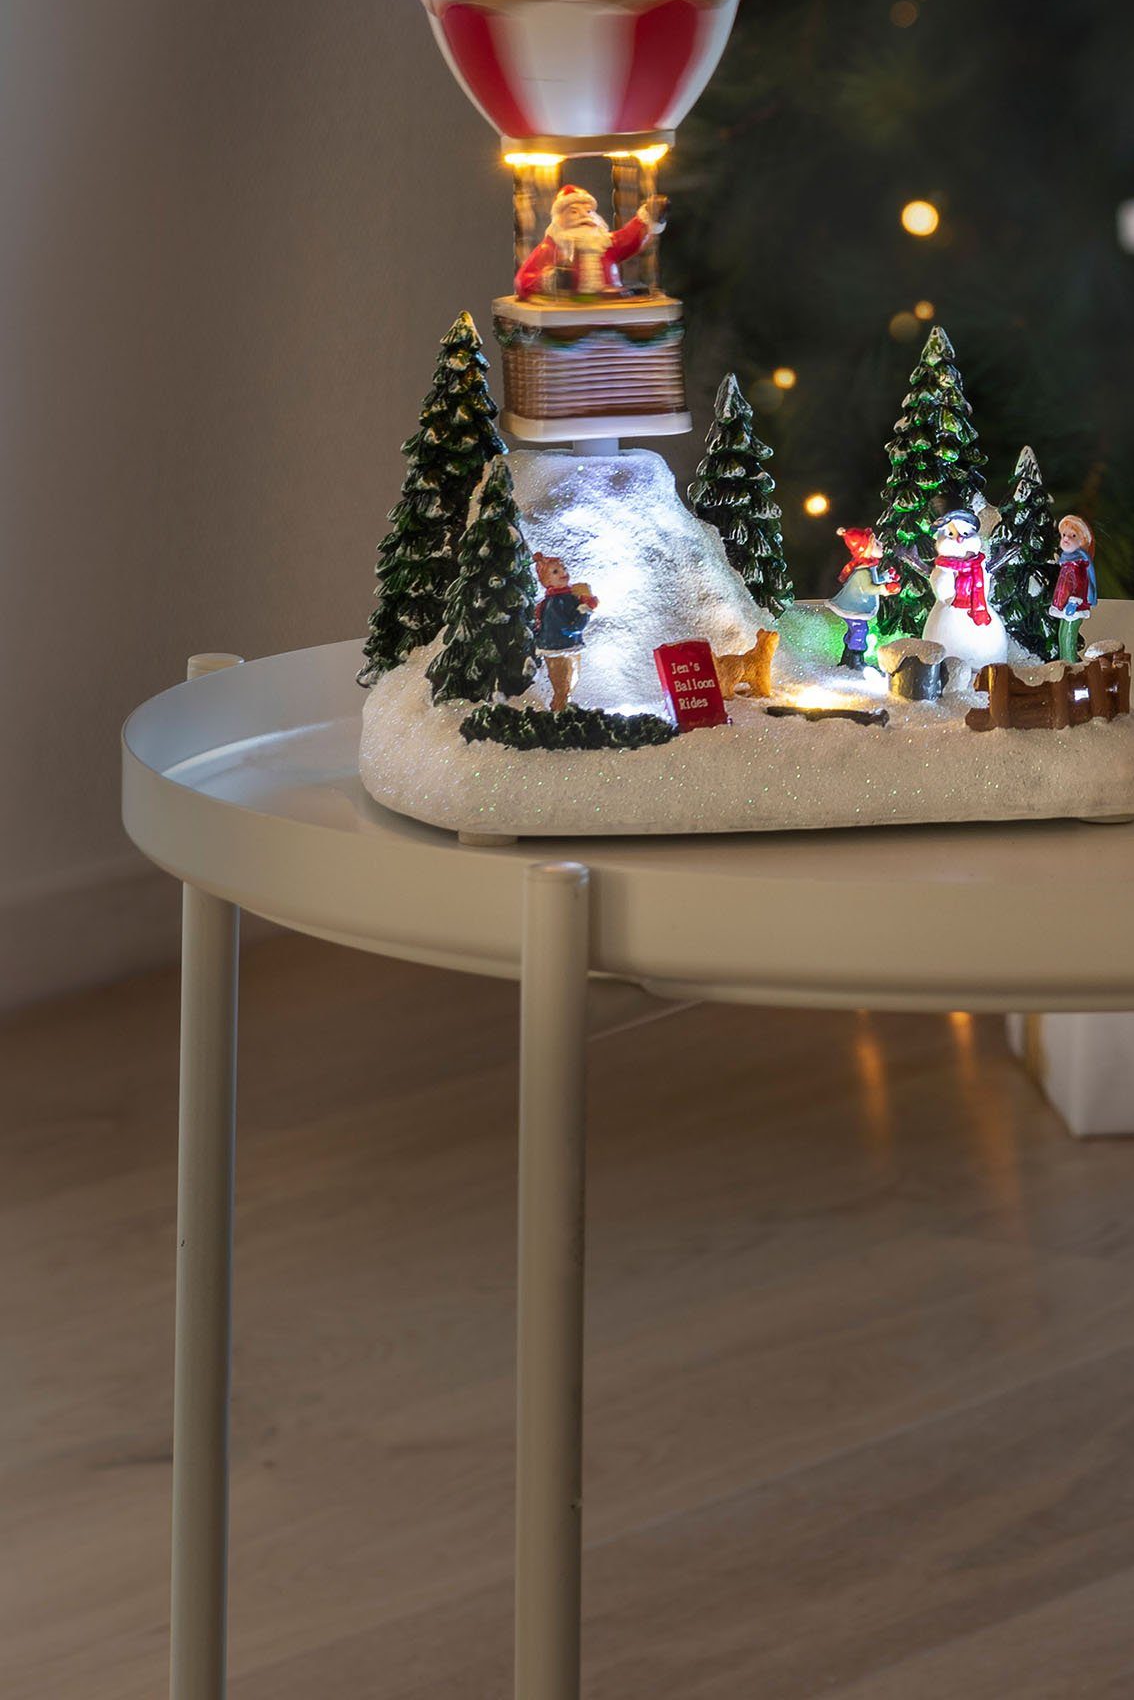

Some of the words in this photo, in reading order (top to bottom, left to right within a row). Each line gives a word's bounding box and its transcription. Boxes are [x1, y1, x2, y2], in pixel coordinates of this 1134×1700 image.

[671, 661, 701, 675] Jen's
[674, 678, 716, 693] Balloon
[679, 696, 709, 710] Rides
